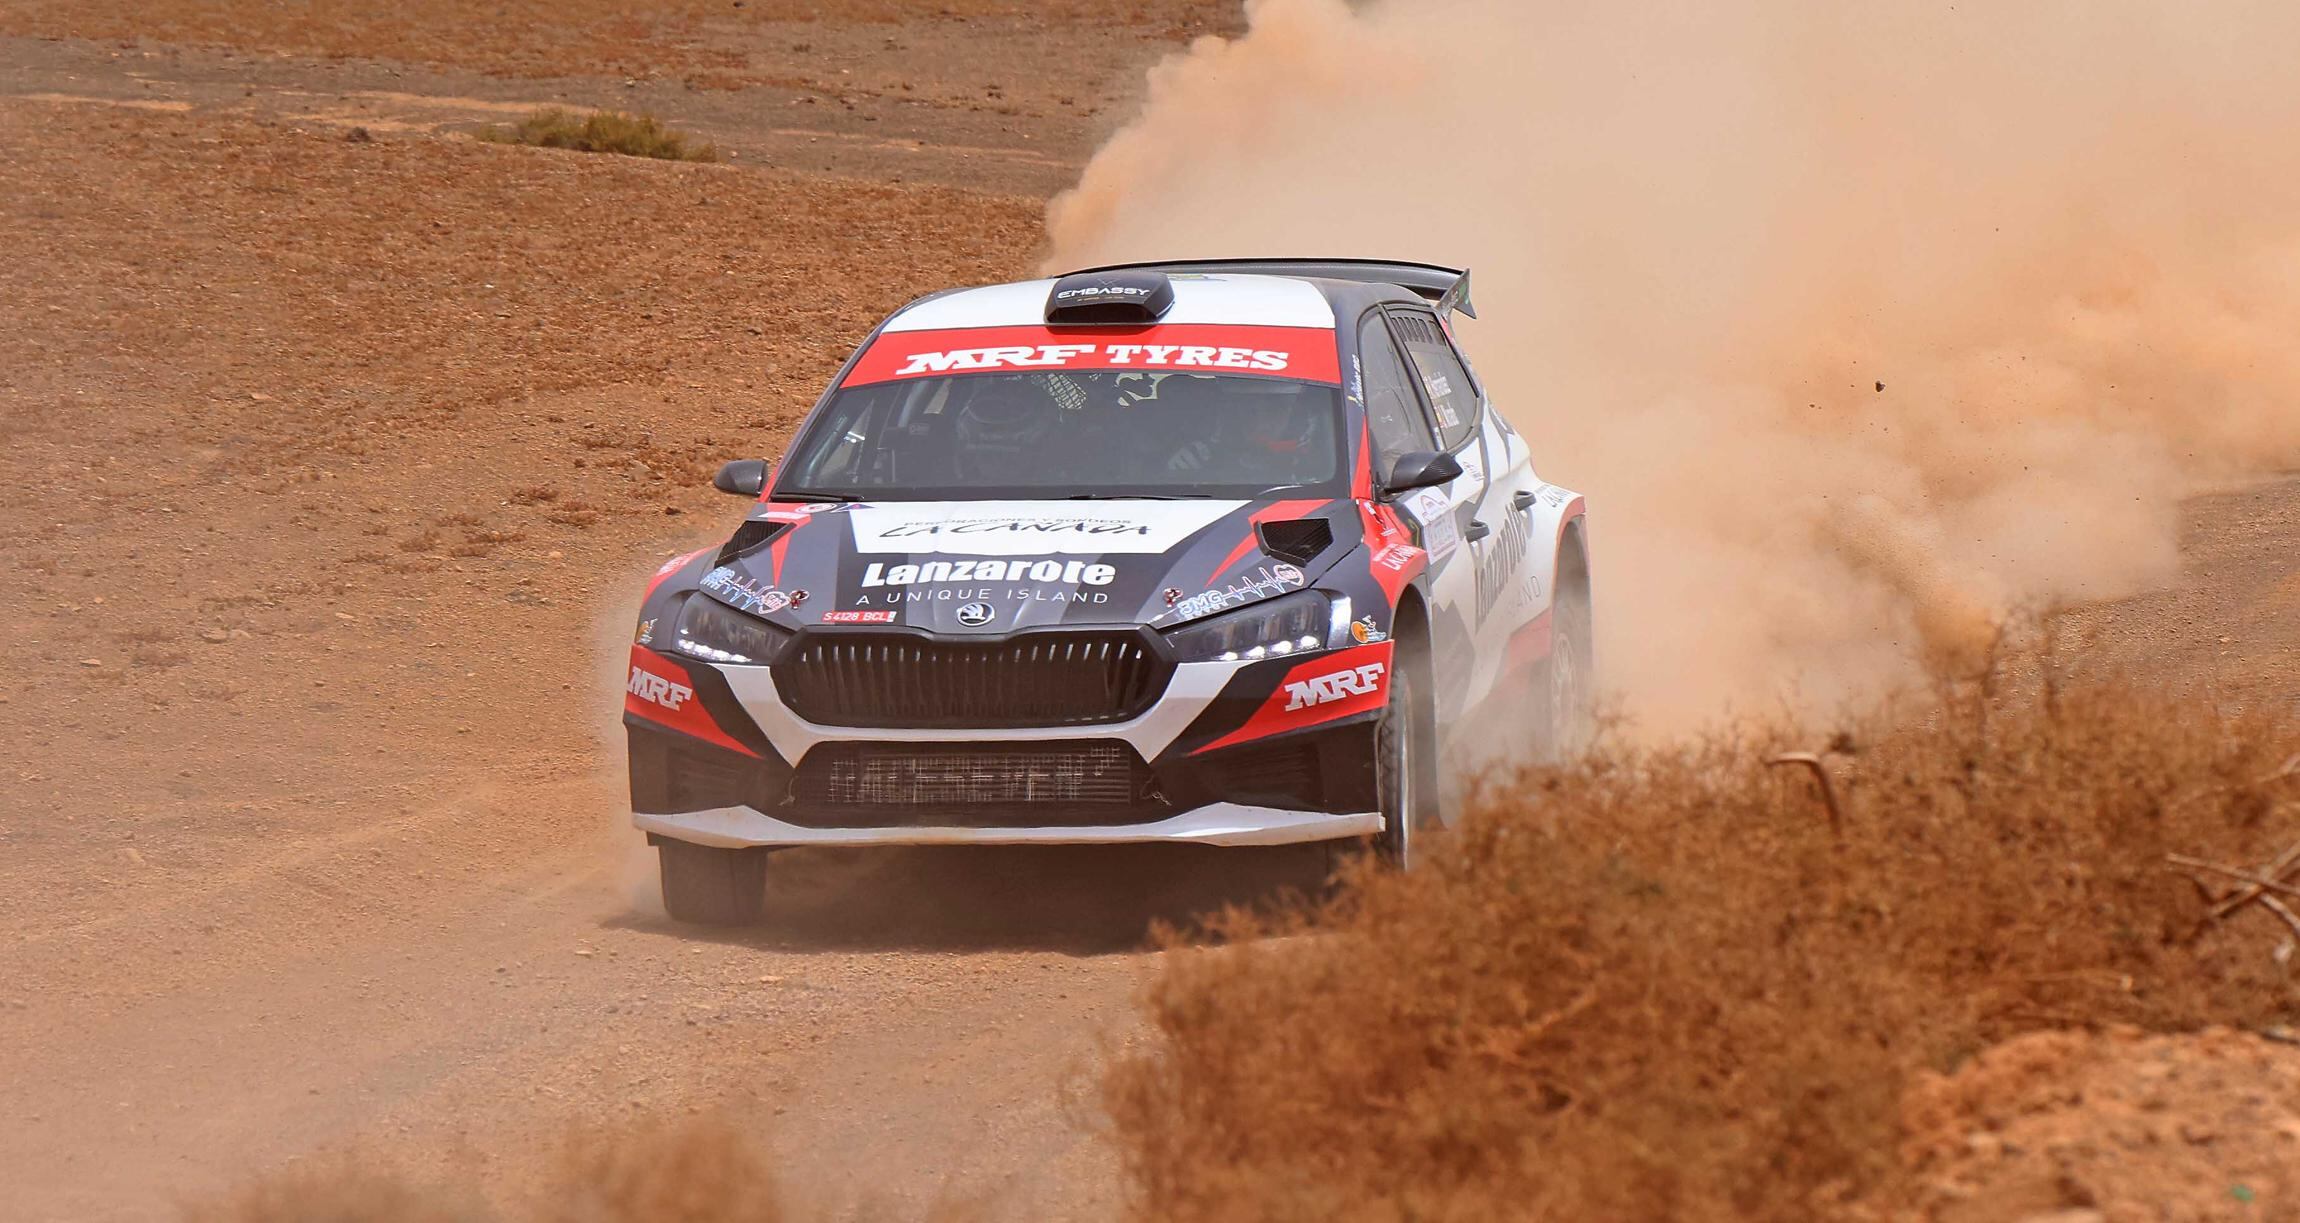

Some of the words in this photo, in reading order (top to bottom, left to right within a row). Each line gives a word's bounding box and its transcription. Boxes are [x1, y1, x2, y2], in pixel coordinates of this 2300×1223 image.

[1057, 286, 1150, 299] EMBASSY
[896, 344, 1096, 375] MRF
[1106, 345, 1289, 371] TYRES
[861, 559, 1116, 588] Lanzarote
[855, 594, 870, 606] A
[886, 588, 991, 604] UNIQUE
[1007, 587, 1108, 603] ISLAND
[823, 611, 833, 621] S
[862, 611, 887, 621] BCL
[626, 665, 693, 712] MRF
[1284, 662, 1385, 712] MRF
